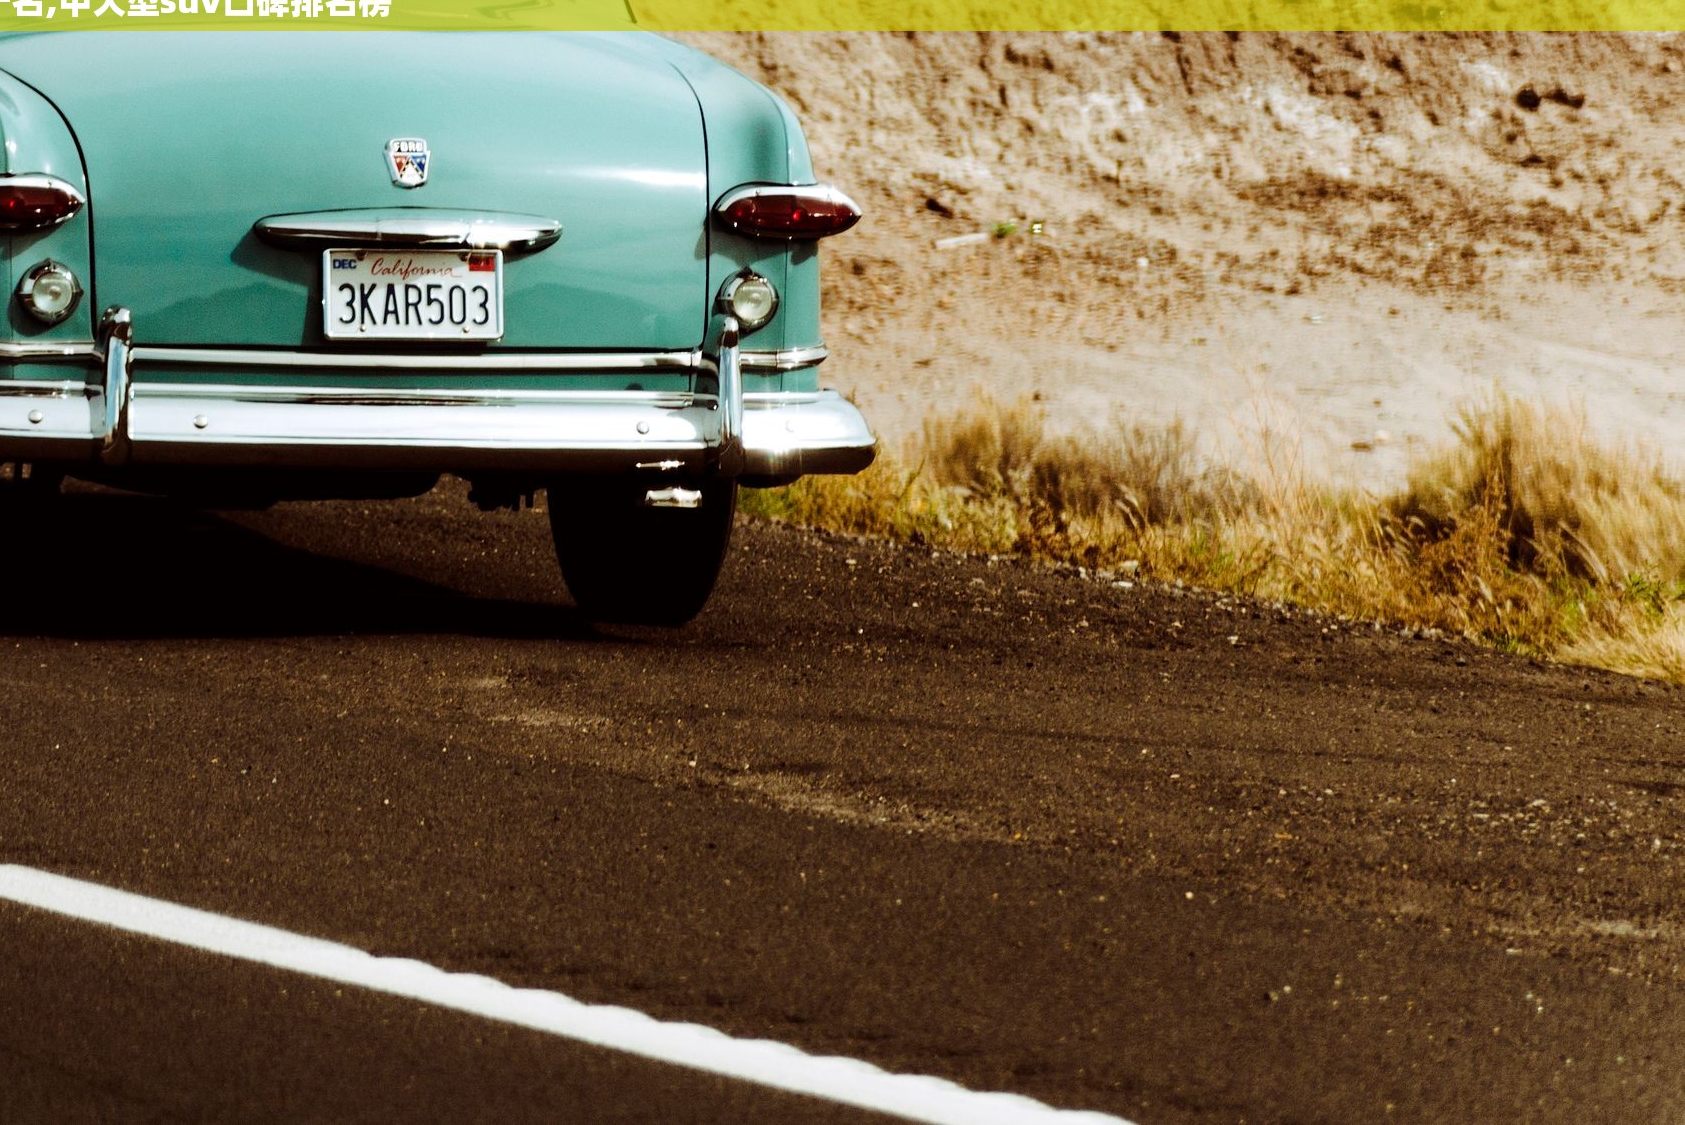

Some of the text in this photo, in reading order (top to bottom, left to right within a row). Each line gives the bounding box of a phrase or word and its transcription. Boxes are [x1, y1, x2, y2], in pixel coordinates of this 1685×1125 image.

[393, 141, 424, 153] FORD
[332, 259, 357, 270] DEC
[370, 257, 463, 280] California
[338, 282, 490, 326] 3KAR503
